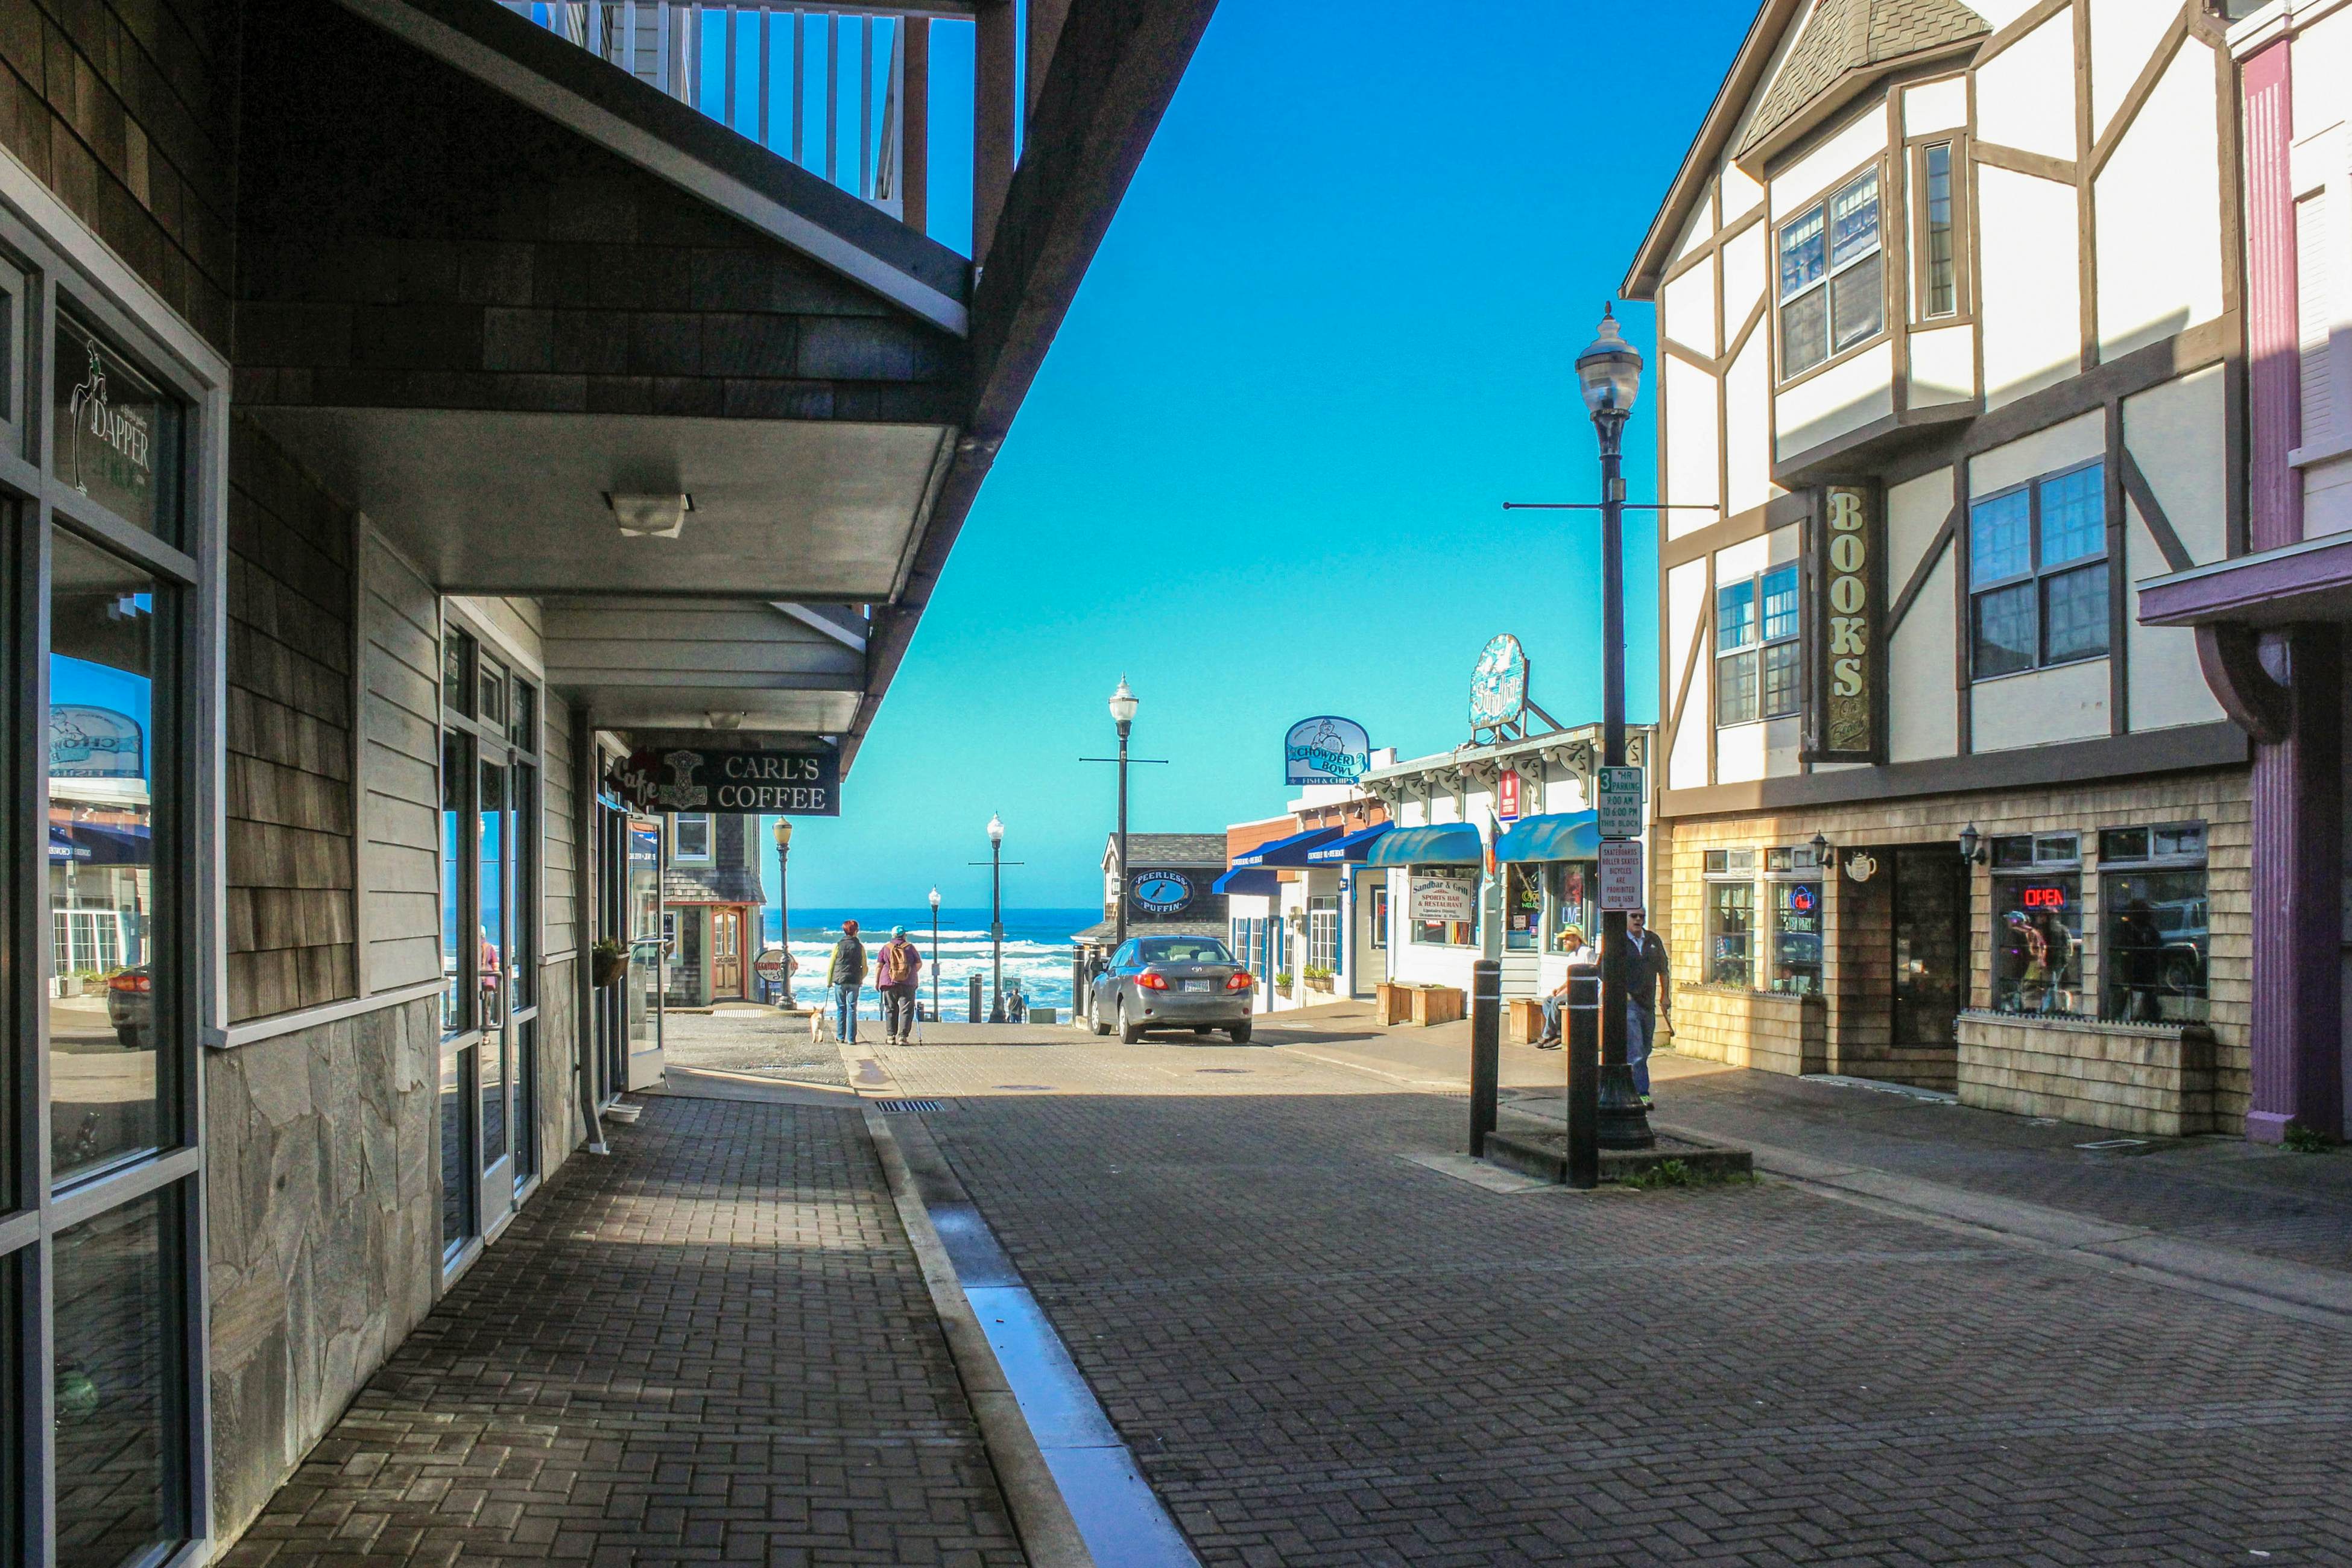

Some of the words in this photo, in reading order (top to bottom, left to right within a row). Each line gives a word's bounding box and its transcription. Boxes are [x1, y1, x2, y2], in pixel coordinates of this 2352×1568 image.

[95, 399, 150, 473] DAPPER
[1830, 492, 1866, 697] BOOKS
[1297, 748, 1350, 765] CHOWDER
[725, 757, 820, 781] CARL'S
[1322, 760, 1353, 776] BOWL
[1601, 773, 1610, 789] 3
[1611, 782, 1639, 791] PARKING
[718, 786, 826, 809] COFFEE
[1137, 871, 1186, 885] PEERLESS
[1413, 880, 1443, 893] Sandbar
[1453, 883, 1468, 896] Grill
[2025, 889, 2064, 906] OPEN
[1143, 902, 1180, 912] PUFFIN
[1005, 980, 1013, 989] P
